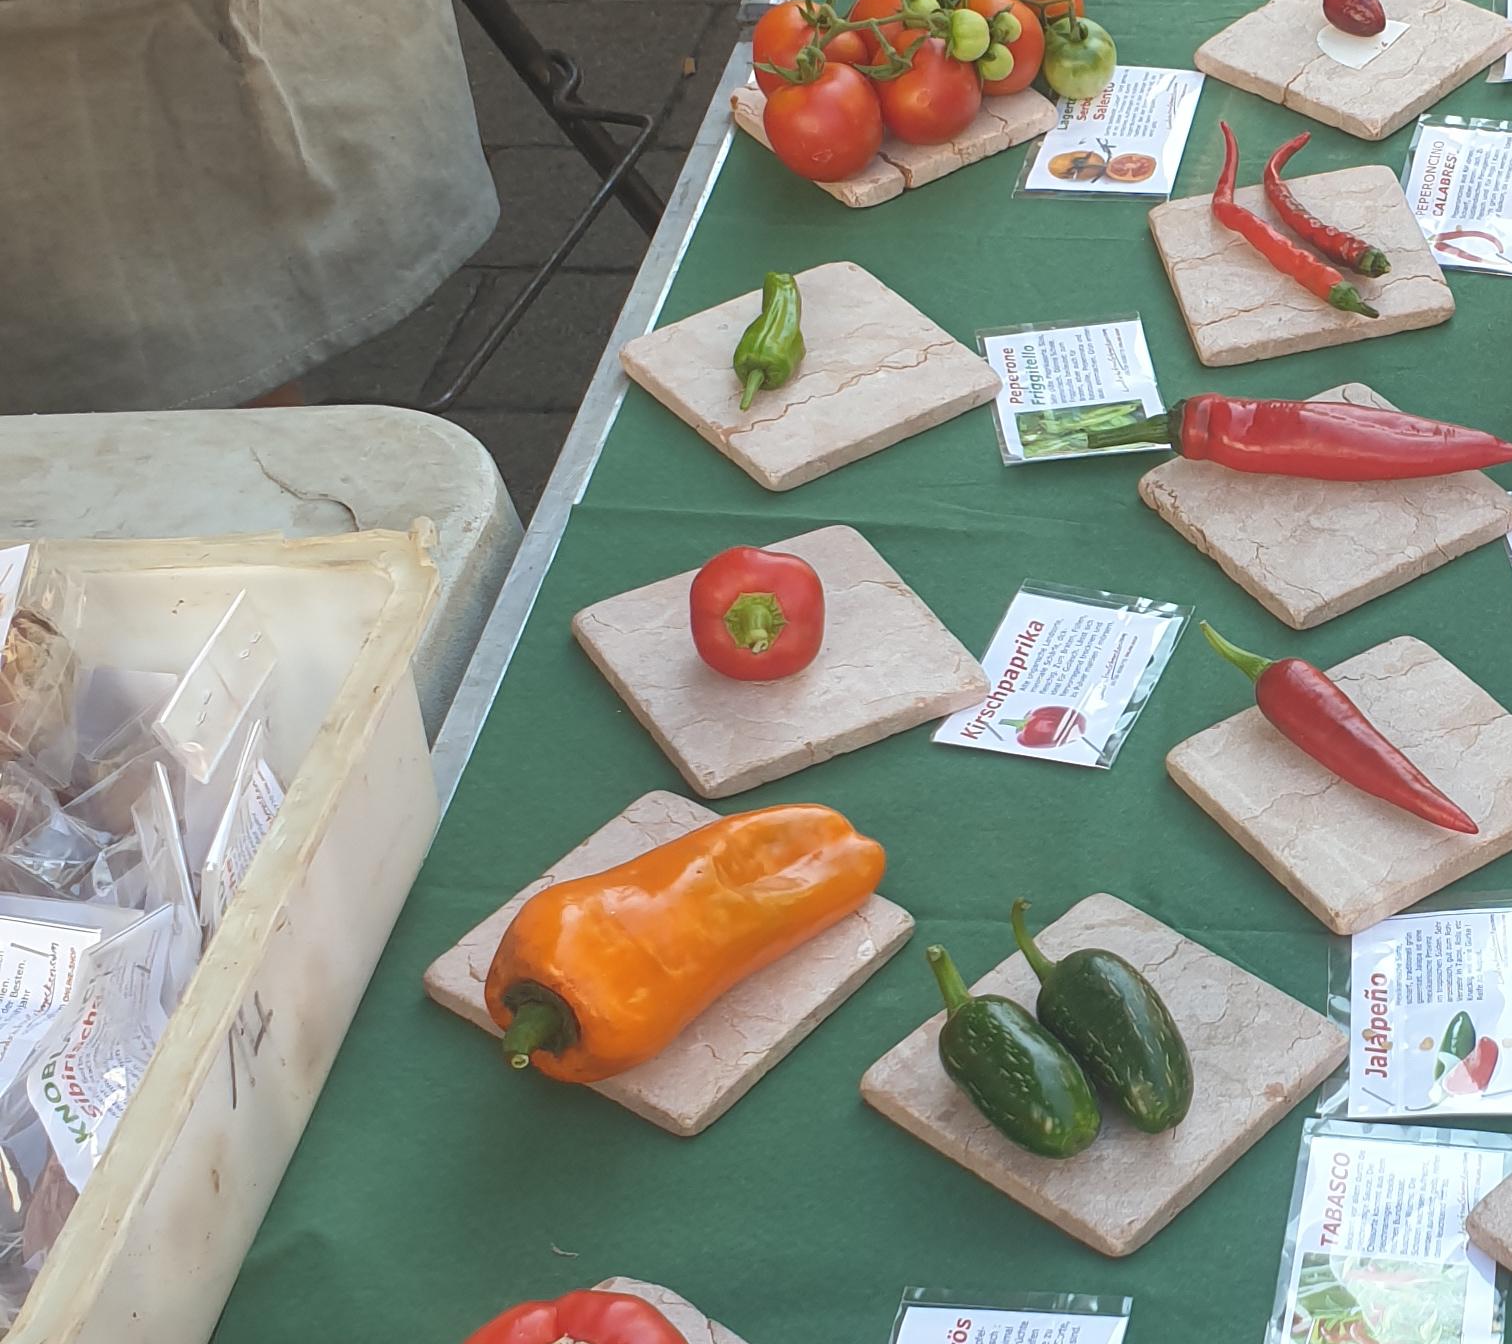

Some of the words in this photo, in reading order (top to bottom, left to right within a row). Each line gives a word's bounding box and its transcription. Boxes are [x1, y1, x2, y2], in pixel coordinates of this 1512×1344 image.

[1415, 140, 1445, 216] PEPERONCINO
[1432, 152, 1457, 217] CALABRES
[1002, 347, 1026, 405] Peperone
[1023, 344, 1047, 406] Friggitello
[959, 618, 1046, 741] Kirschpaprika
[1362, 972, 1390, 1078] Jalapeño
[1320, 1151, 1352, 1250] TABASCO
